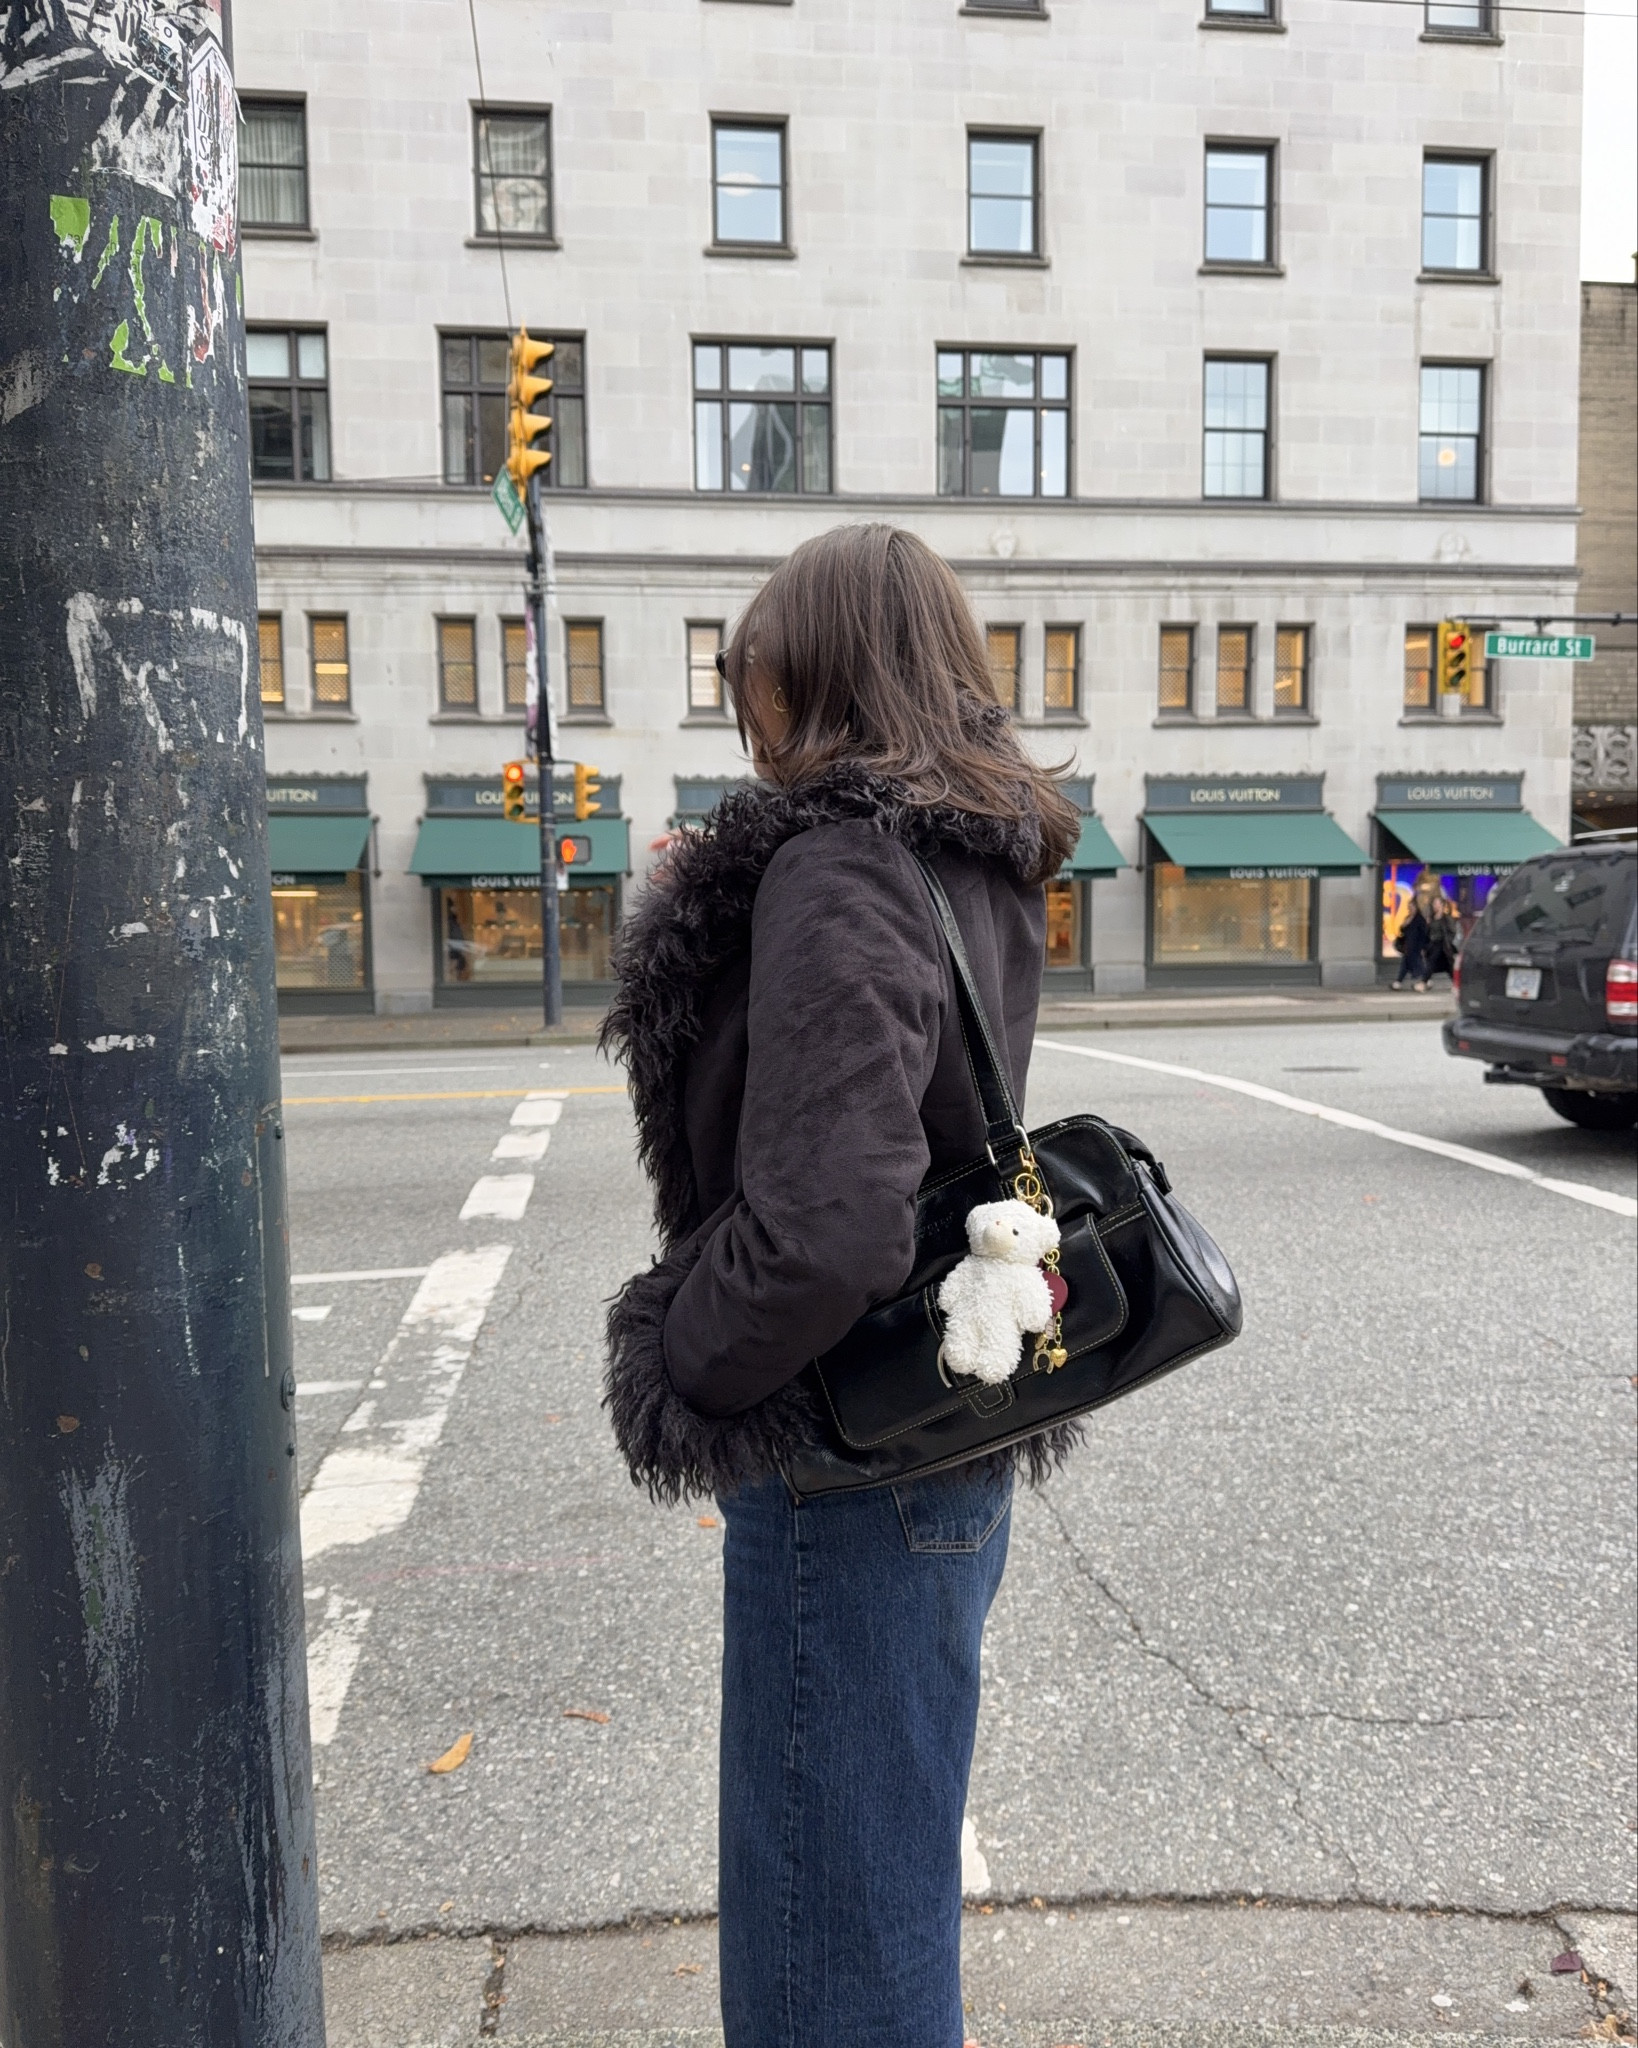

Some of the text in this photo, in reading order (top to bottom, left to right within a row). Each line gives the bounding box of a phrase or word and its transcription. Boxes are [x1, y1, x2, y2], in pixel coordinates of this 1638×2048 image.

[1497, 637, 1582, 657] Burrard St
[265, 788, 318, 802] UITTON
[1190, 787, 1281, 803] LOUIS VUITTON
[1406, 786, 1494, 801] LOUIS VUITTON
[1229, 866, 1320, 880] LOUIS VUITTON
[1456, 864, 1491, 877] LOUIS
[471, 876, 510, 889] LOUIS
